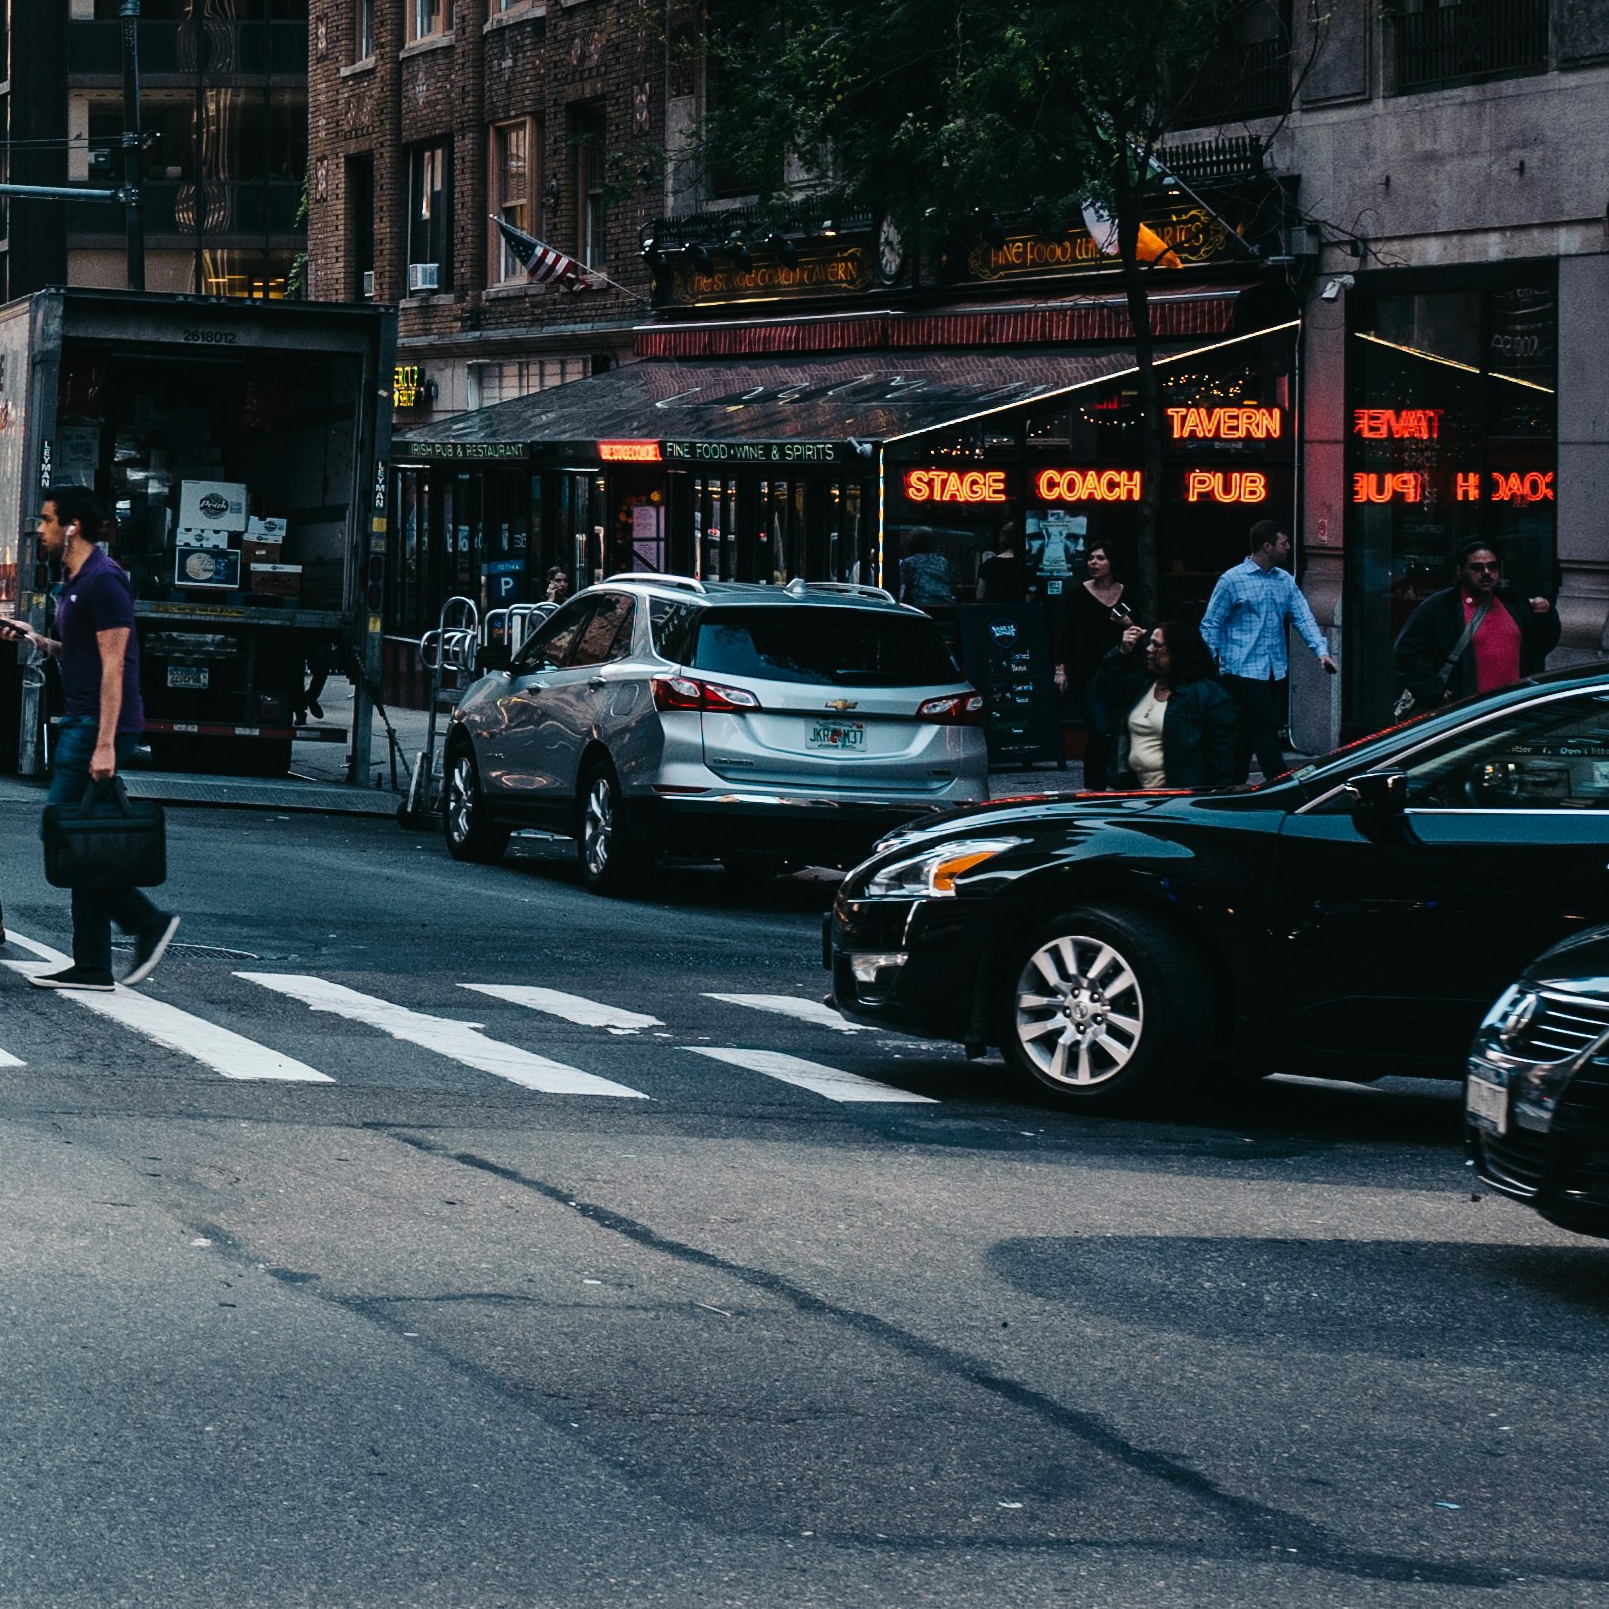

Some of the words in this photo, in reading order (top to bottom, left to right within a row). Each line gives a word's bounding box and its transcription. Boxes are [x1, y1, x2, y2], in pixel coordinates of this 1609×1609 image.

[183, 329, 237, 344] 2618012
[1167, 407, 1280, 439] TAVERN
[410, 443, 432, 456] IRISH
[435, 443, 453, 457] PUB
[455, 444, 463, 457] &
[465, 443, 524, 458] RESTAURANT
[666, 442, 691, 459] FINE
[695, 443, 729, 460] FOOD
[734, 444, 766, 460] WINE
[770, 446, 780, 460] &
[784, 444, 835, 461] SPIRITS
[41, 440, 51, 488] LEYMAN
[375, 461, 384, 509] LEYMAN
[907, 470, 1006, 502] STAGE
[1038, 469, 1141, 502] COACH
[1187, 472, 1267, 503] PUB
[500, 577, 514, 597] P
